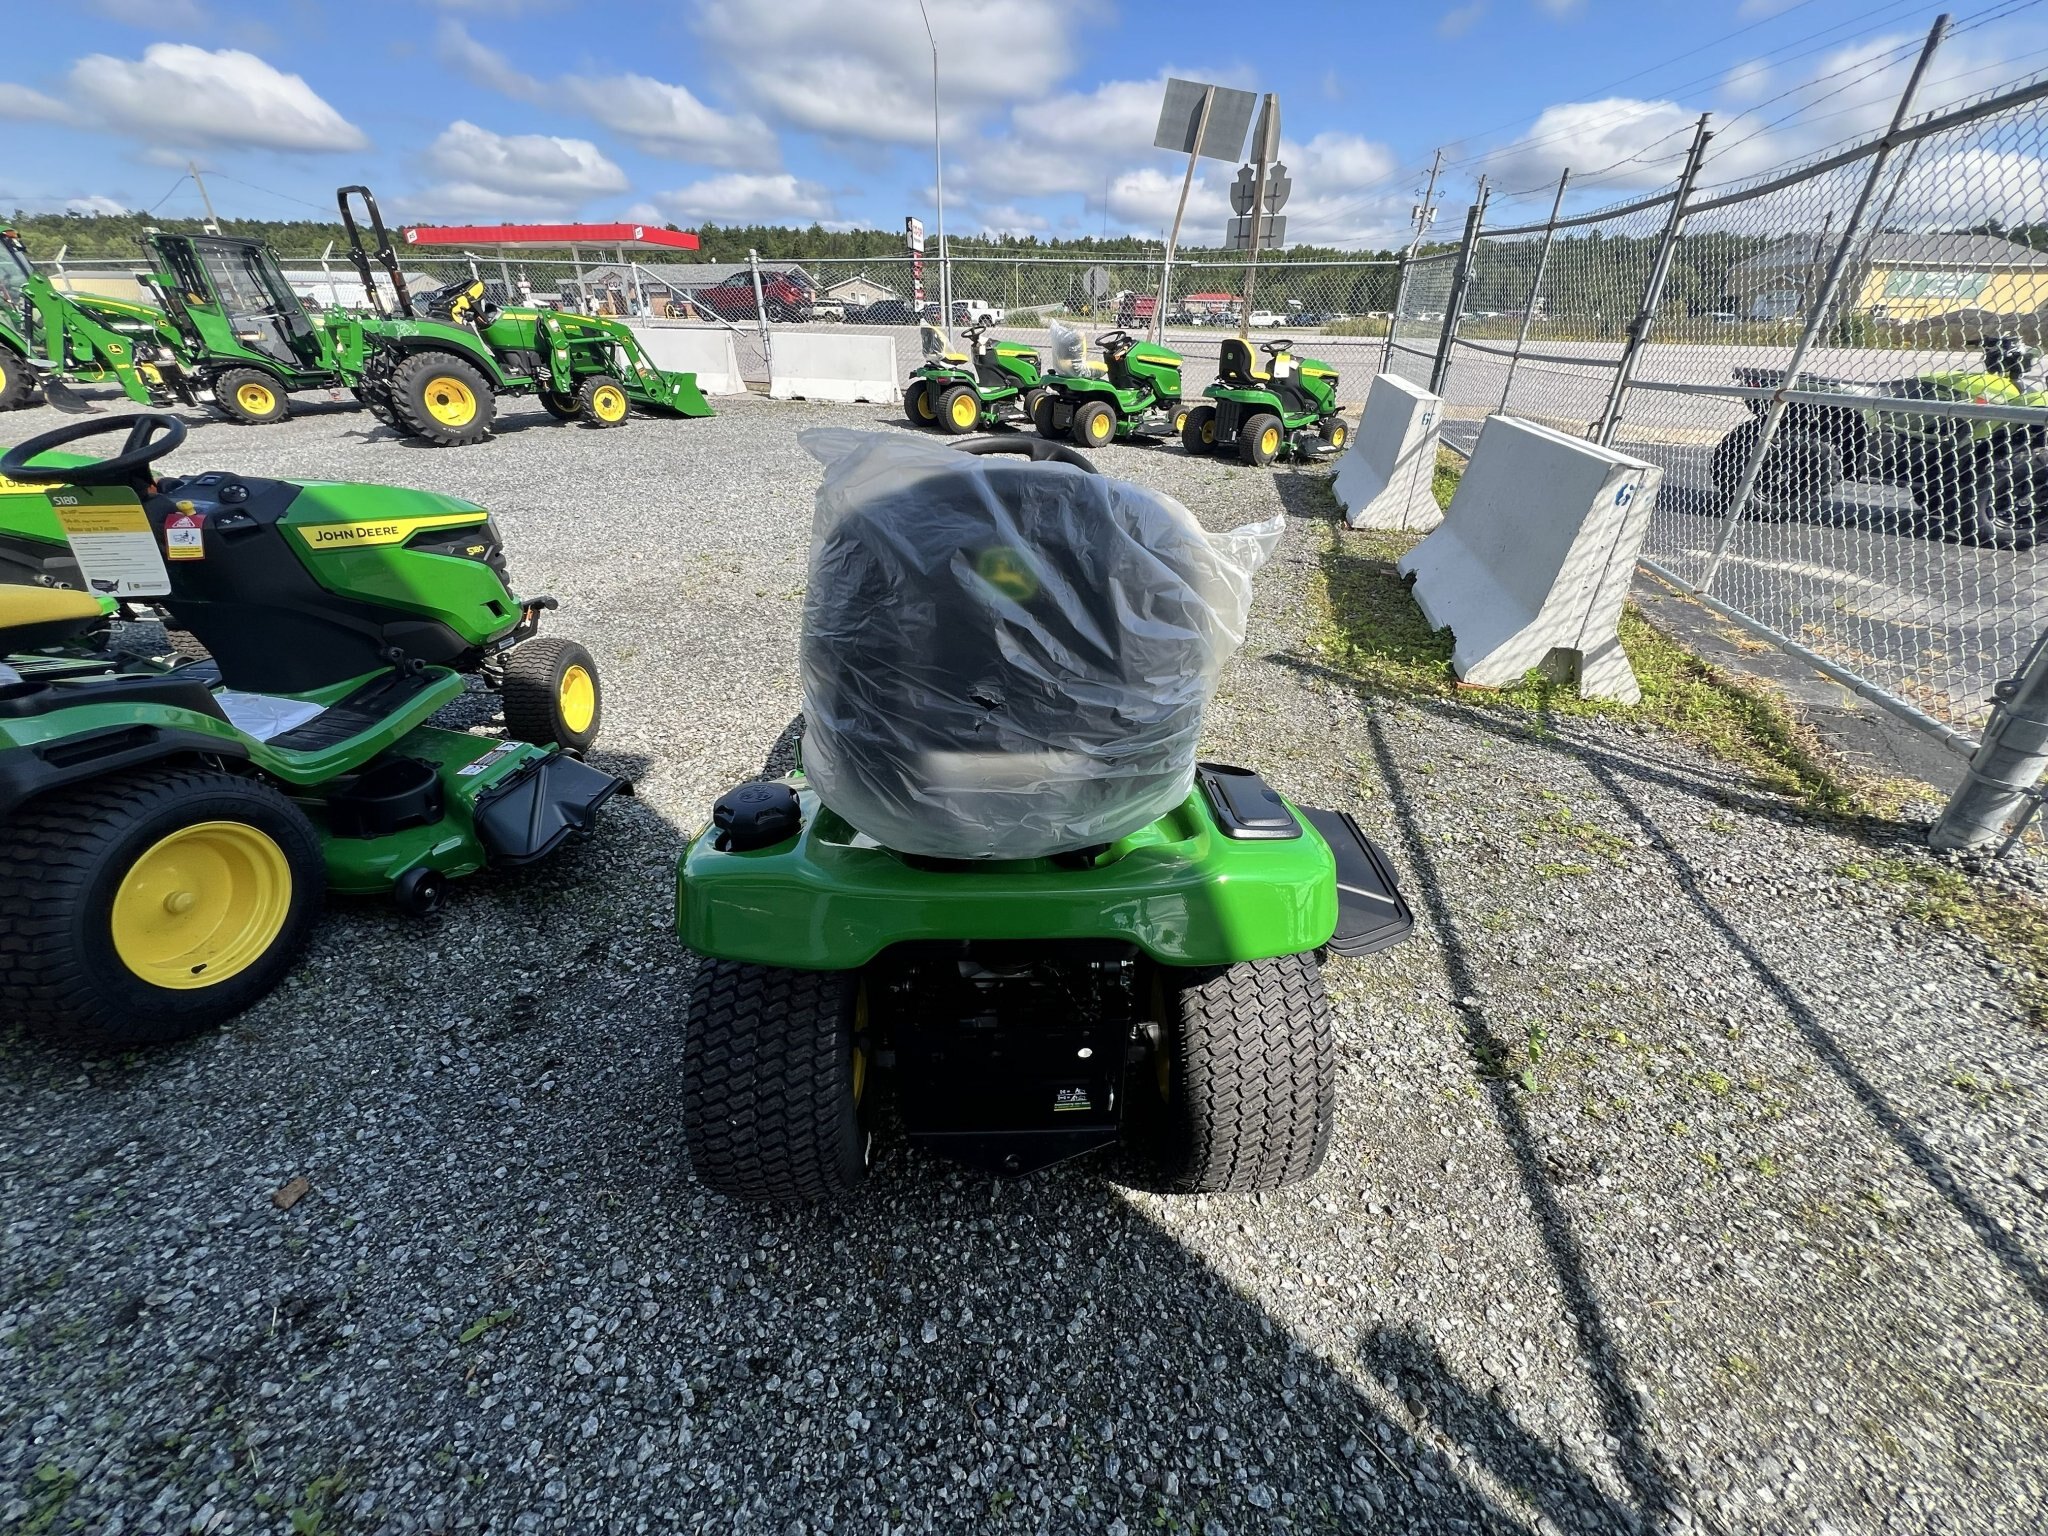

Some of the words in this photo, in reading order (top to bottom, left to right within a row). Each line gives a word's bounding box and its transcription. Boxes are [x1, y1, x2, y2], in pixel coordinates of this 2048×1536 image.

[53, 496, 78, 505] S180
[315, 529, 354, 542] JOHN
[356, 526, 399, 538] DEERE
